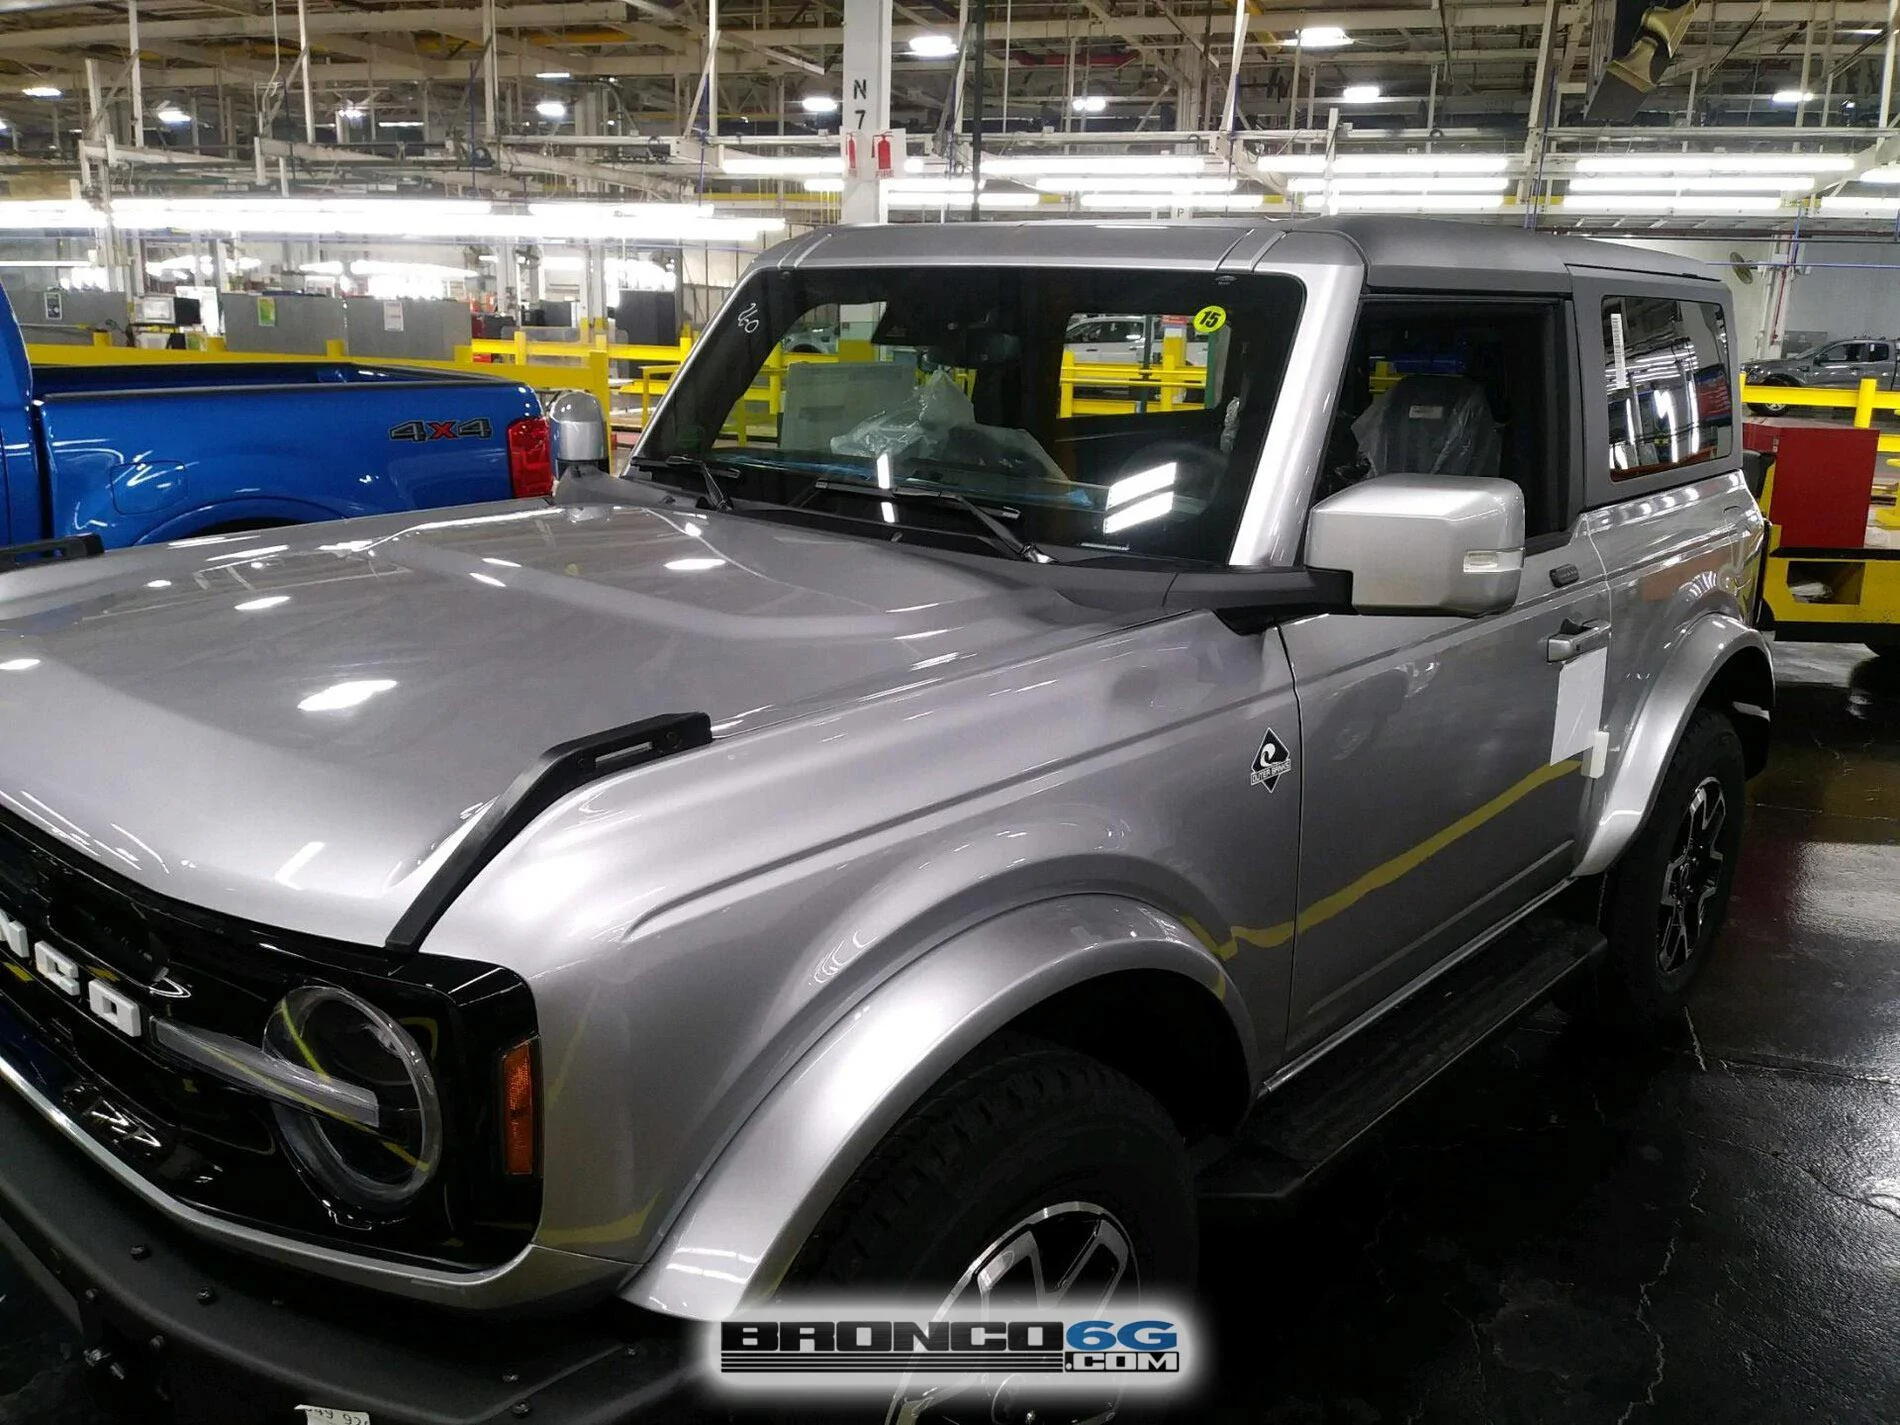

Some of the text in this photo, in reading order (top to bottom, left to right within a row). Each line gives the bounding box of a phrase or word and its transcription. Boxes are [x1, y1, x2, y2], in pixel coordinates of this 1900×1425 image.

[853, 79, 867, 99] N
[854, 110, 866, 129] 7
[1200, 311, 1221, 328] 15
[1252, 769, 1271, 784] OUTER
